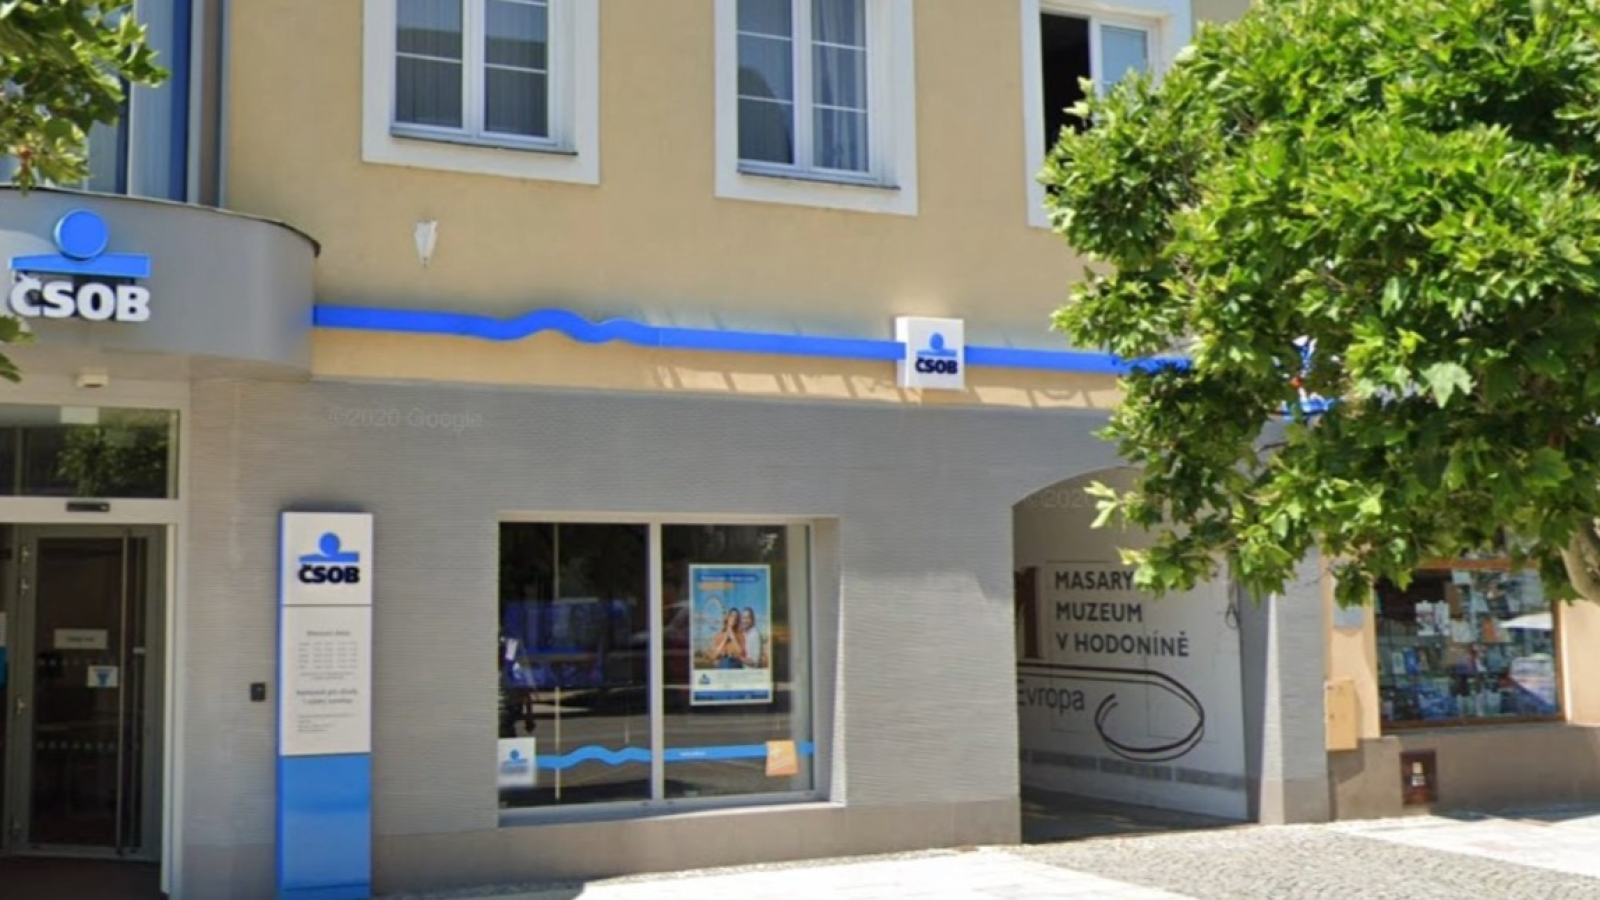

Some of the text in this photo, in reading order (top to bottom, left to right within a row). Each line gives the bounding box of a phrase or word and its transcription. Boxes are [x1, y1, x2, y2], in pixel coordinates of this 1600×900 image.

[10, 271, 151, 321] ČSOB
[915, 356, 958, 375] ČSOB
[298, 565, 360, 584] ČSOB
[1055, 571, 1134, 590] MASARY
[1055, 602, 1142, 622] MUZEUM
[1056, 631, 1189, 657] V HODONÍNĚ
